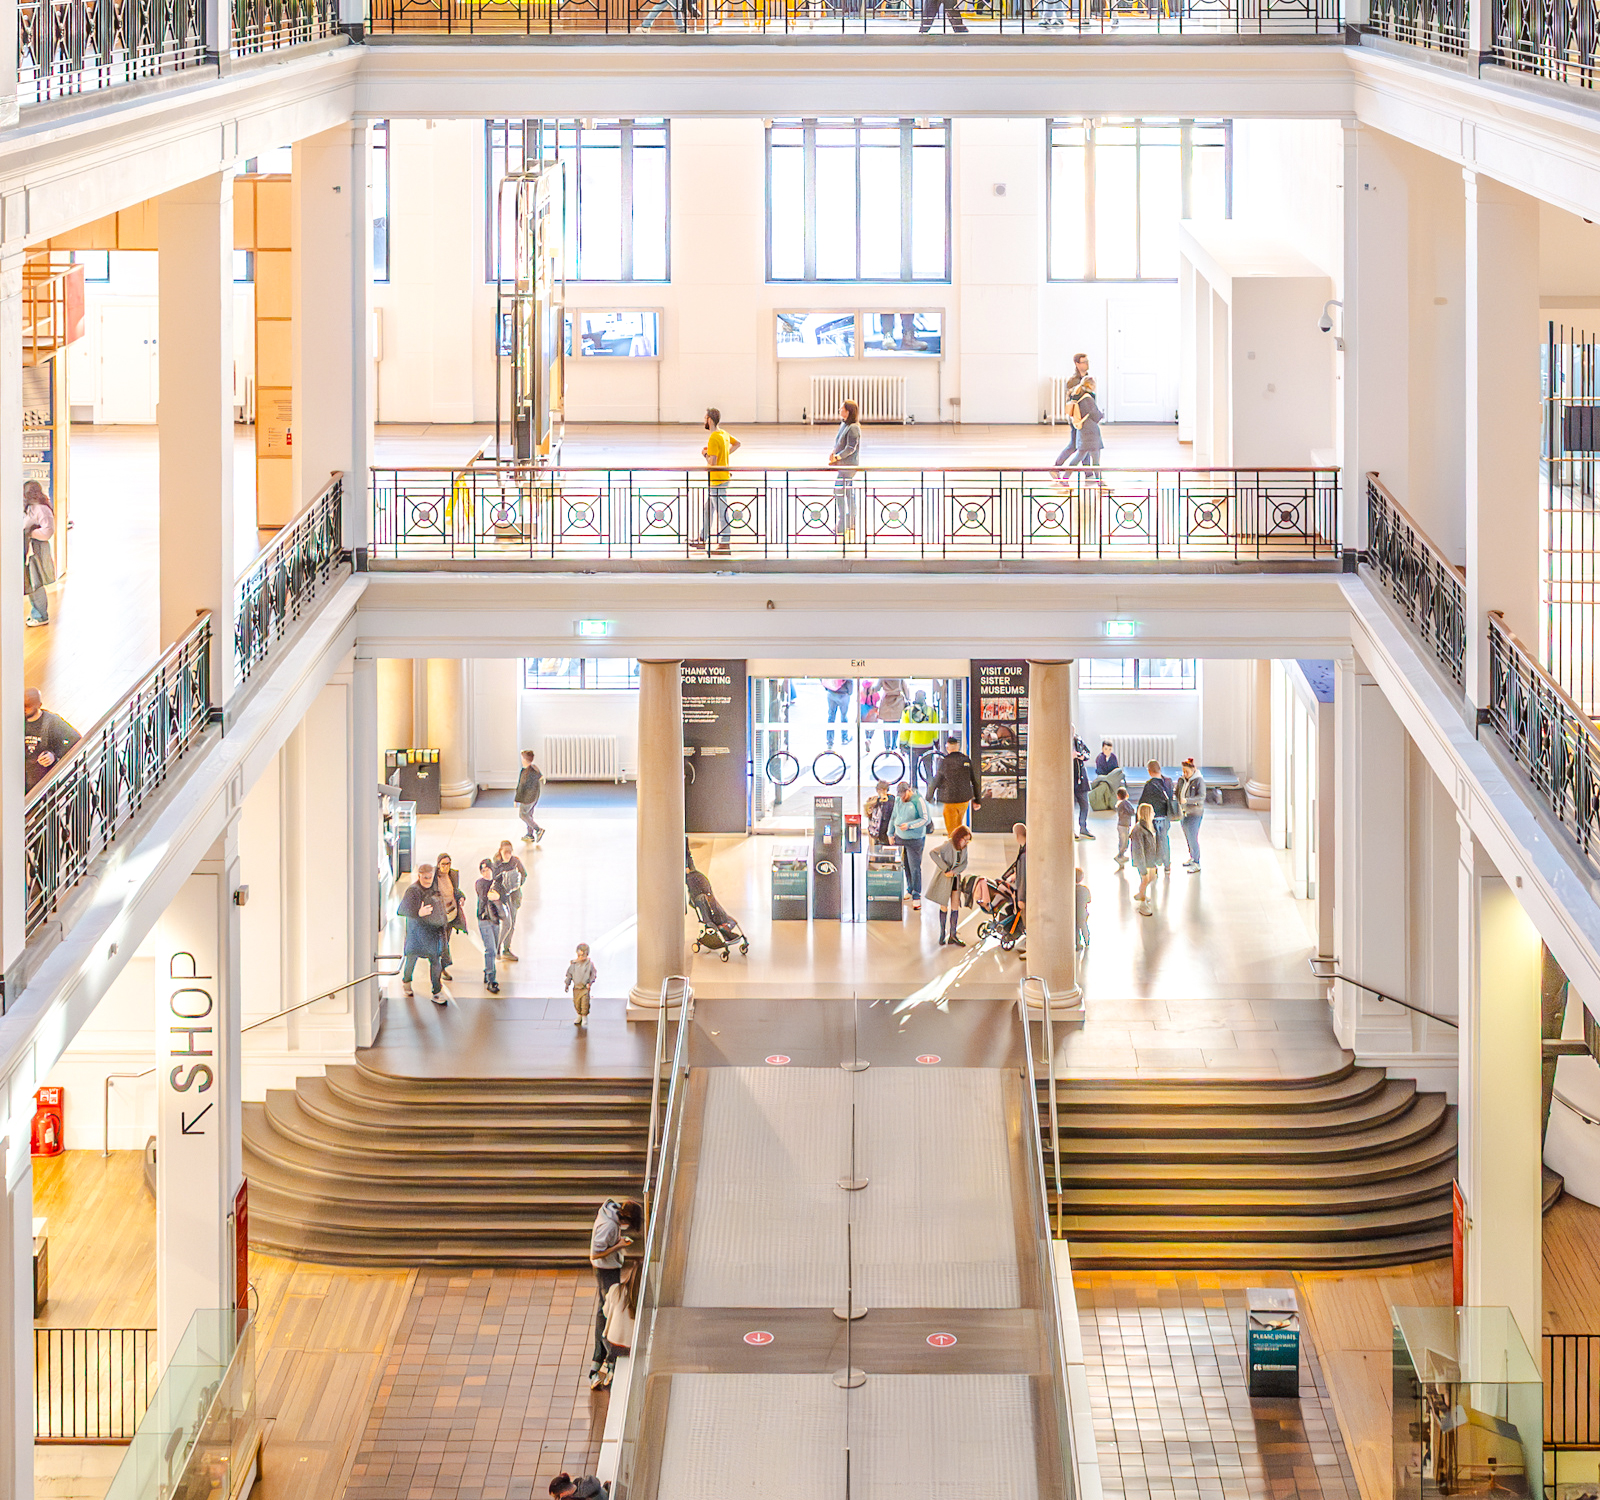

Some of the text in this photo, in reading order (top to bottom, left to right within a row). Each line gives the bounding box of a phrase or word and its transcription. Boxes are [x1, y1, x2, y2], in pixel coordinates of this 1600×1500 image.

[851, 659, 866, 667] Exit
[681, 666, 726, 676] THANK YOU
[980, 666, 1023, 676] VISIT OUR
[681, 675, 731, 685] FOR VISITING
[980, 676, 1011, 686] SISTER
[980, 685, 1025, 695] MUSEUMS
[170, 952, 213, 1093] SHOP
